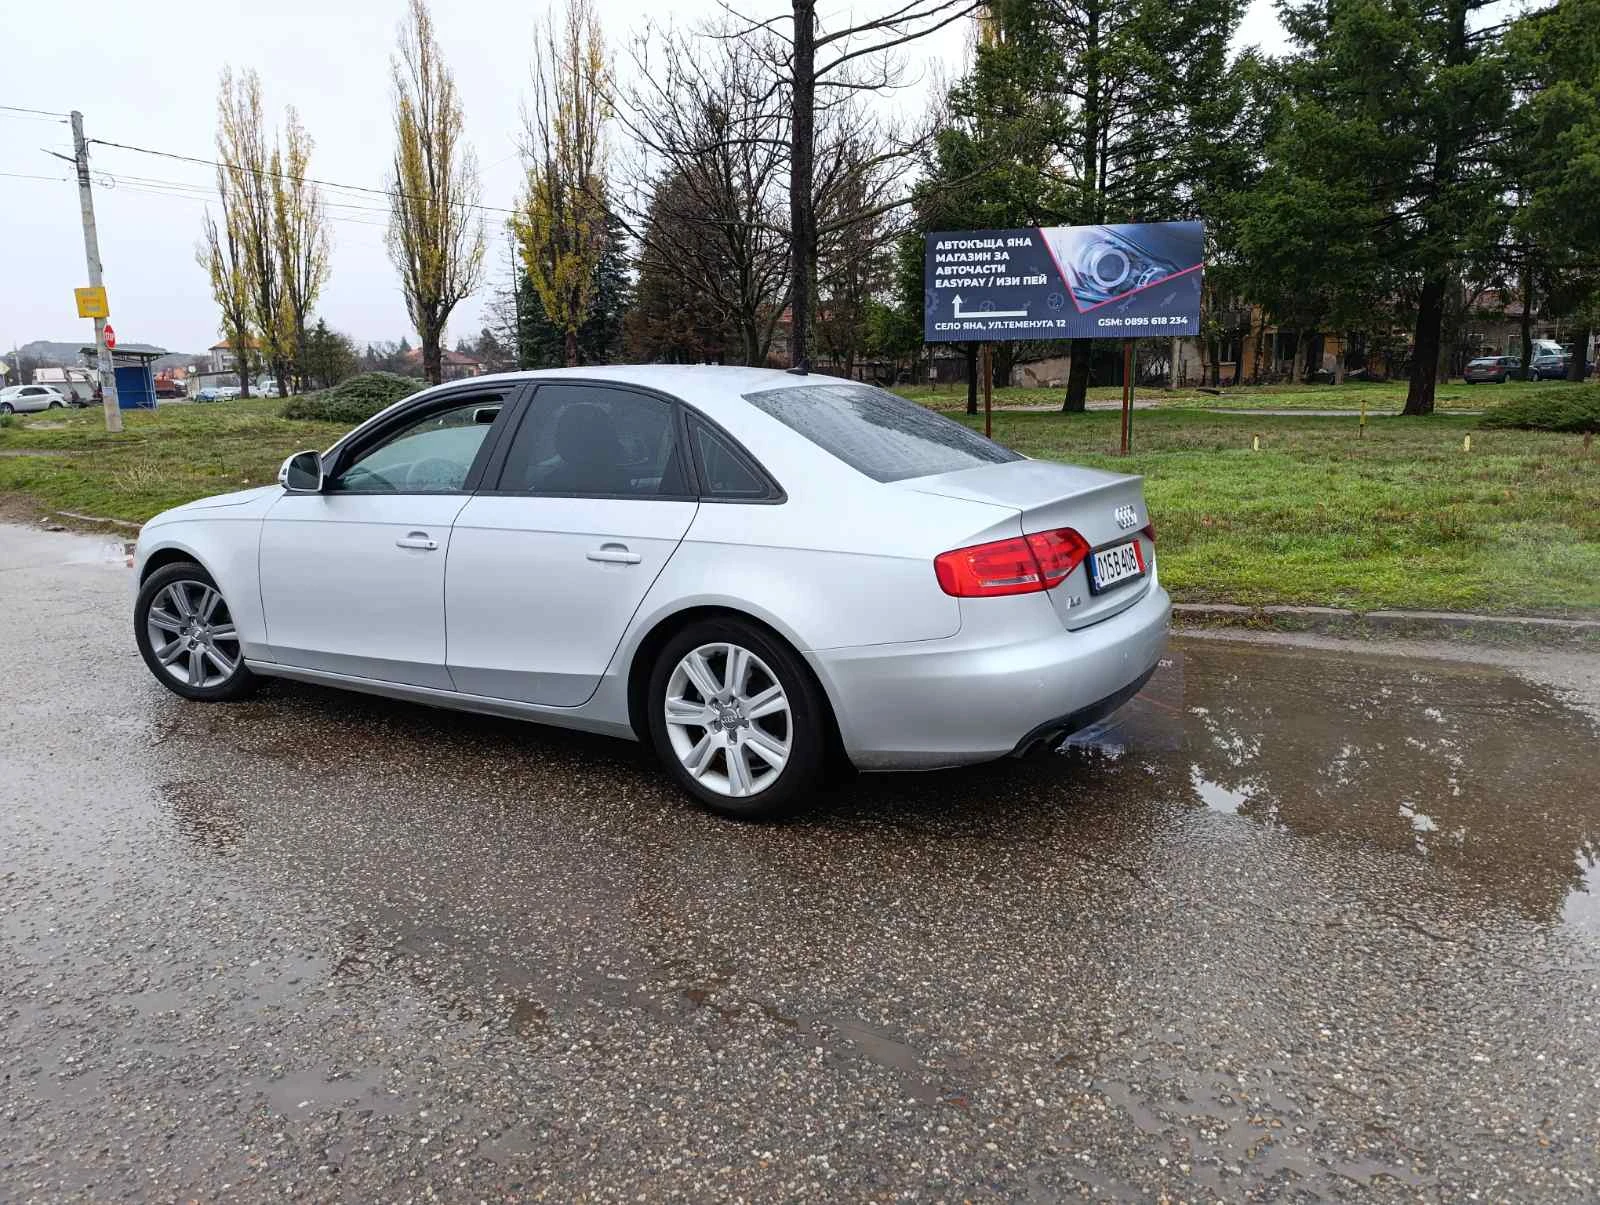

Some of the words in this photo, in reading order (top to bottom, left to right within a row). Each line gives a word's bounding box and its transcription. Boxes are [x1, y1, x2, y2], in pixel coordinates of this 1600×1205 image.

[936, 238, 1004, 250] АВТОКЪЩА
[1007, 237, 1032, 247] ЯНА
[936, 252, 991, 262] МАГАЗИН
[994, 251, 1010, 261] ЗА
[936, 264, 1006, 275] АВТОЧАСТИ
[936, 278, 987, 288] EASYPAY
[996, 277, 1020, 286] ИЗИ
[1023, 274, 1047, 285] ПЕЙ
[935, 322, 961, 330] СЕЛО
[963, 321, 986, 331] ЯНА,
[1056, 320, 1066, 328] 12
[1098, 318, 1123, 327] GSM:
[1125, 317, 1149, 326] 0895
[1151, 317, 1167, 325] 618
[1169, 316, 1188, 324] 234
